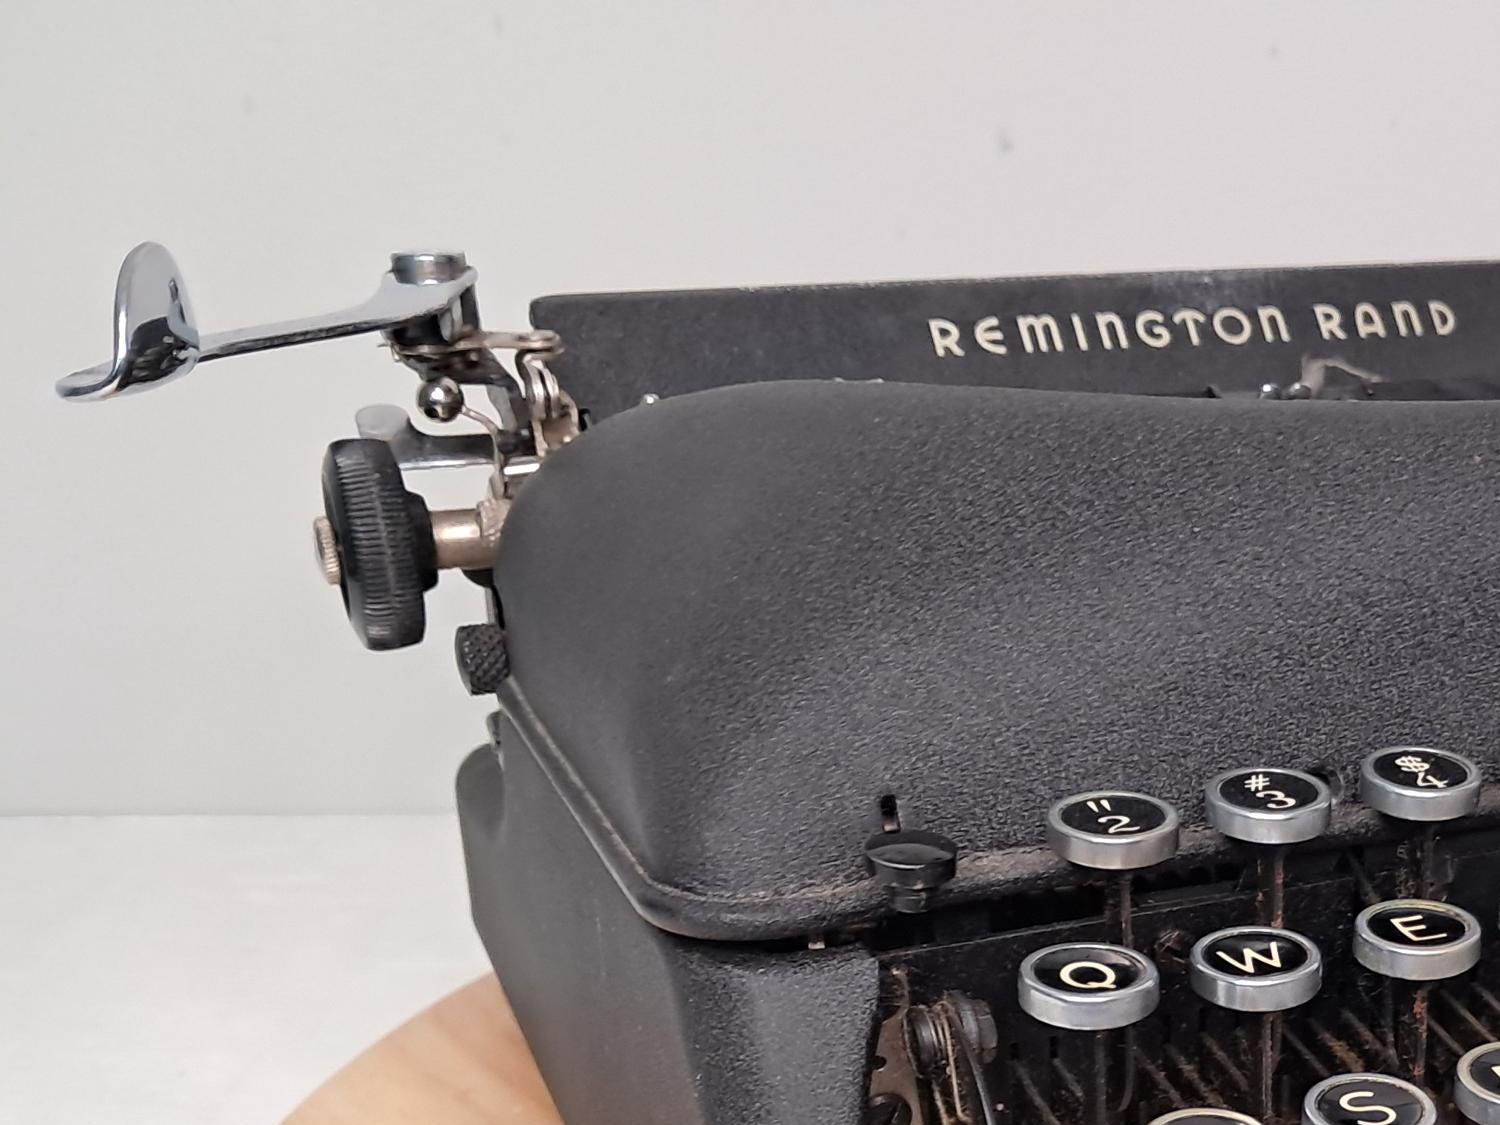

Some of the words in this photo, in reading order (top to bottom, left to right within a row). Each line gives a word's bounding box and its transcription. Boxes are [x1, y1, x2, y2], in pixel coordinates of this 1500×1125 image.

[929, 303, 1291, 359] REMINGTON
[1313, 300, 1457, 340] RAND
[1394, 755, 1430, 774] $
[1244, 774, 1270, 792] #
[1415, 771, 1449, 788] 4
[1255, 790, 1296, 808] 3
[1097, 815, 1141, 834] 2
[1391, 914, 1448, 942] E
[1216, 940, 1283, 974] W
[1059, 960, 1118, 989] Q
